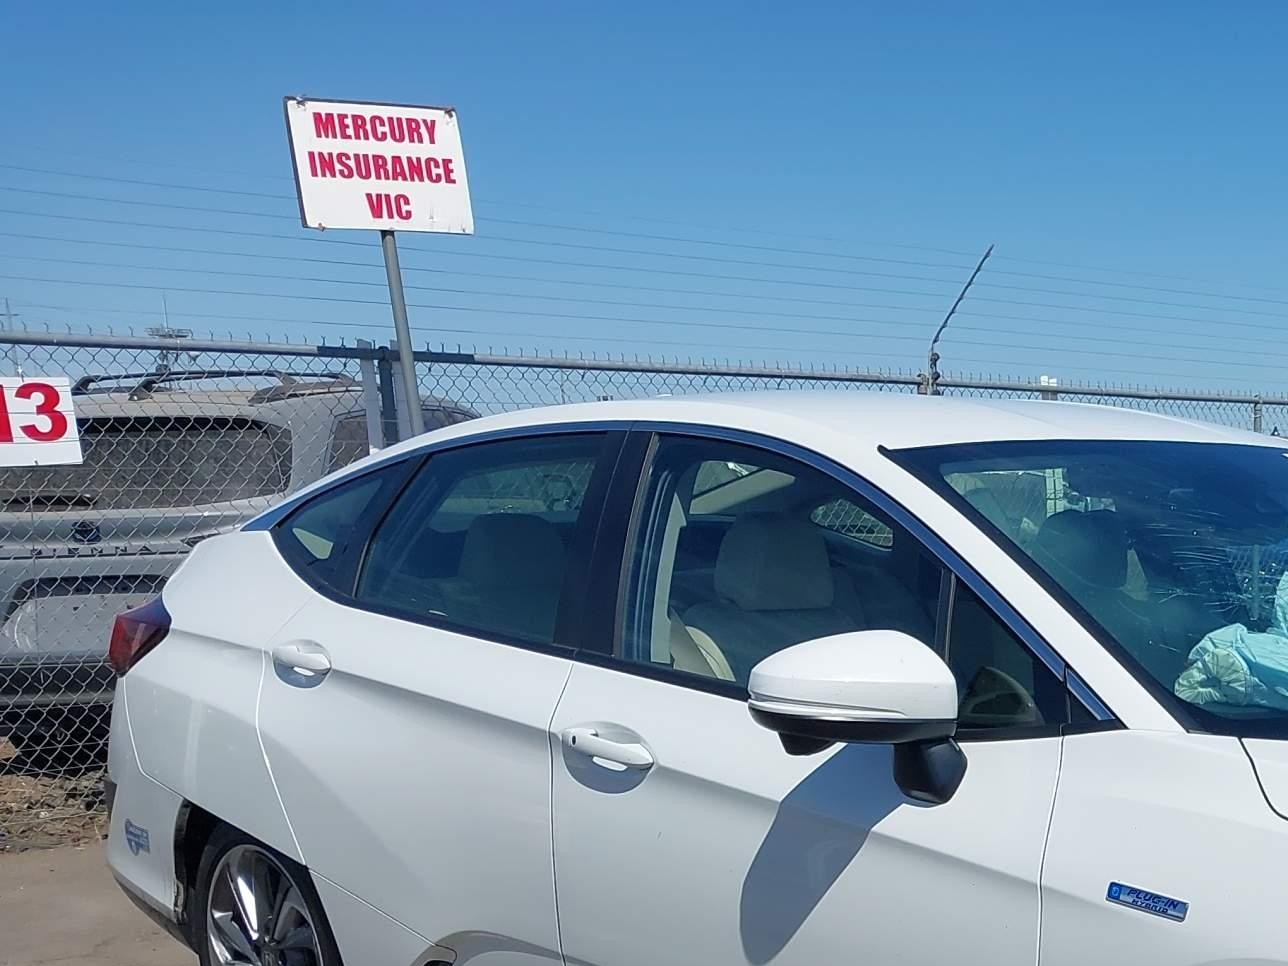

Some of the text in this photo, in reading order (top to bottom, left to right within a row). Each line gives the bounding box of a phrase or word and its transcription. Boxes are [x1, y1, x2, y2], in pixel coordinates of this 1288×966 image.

[312, 112, 436, 144] MERCURY
[307, 151, 457, 184] INSURANCE
[365, 193, 412, 220] VIC
[1127, 889, 1179, 910] PLUG-IN
[1131, 899, 1168, 914] HYBRID
